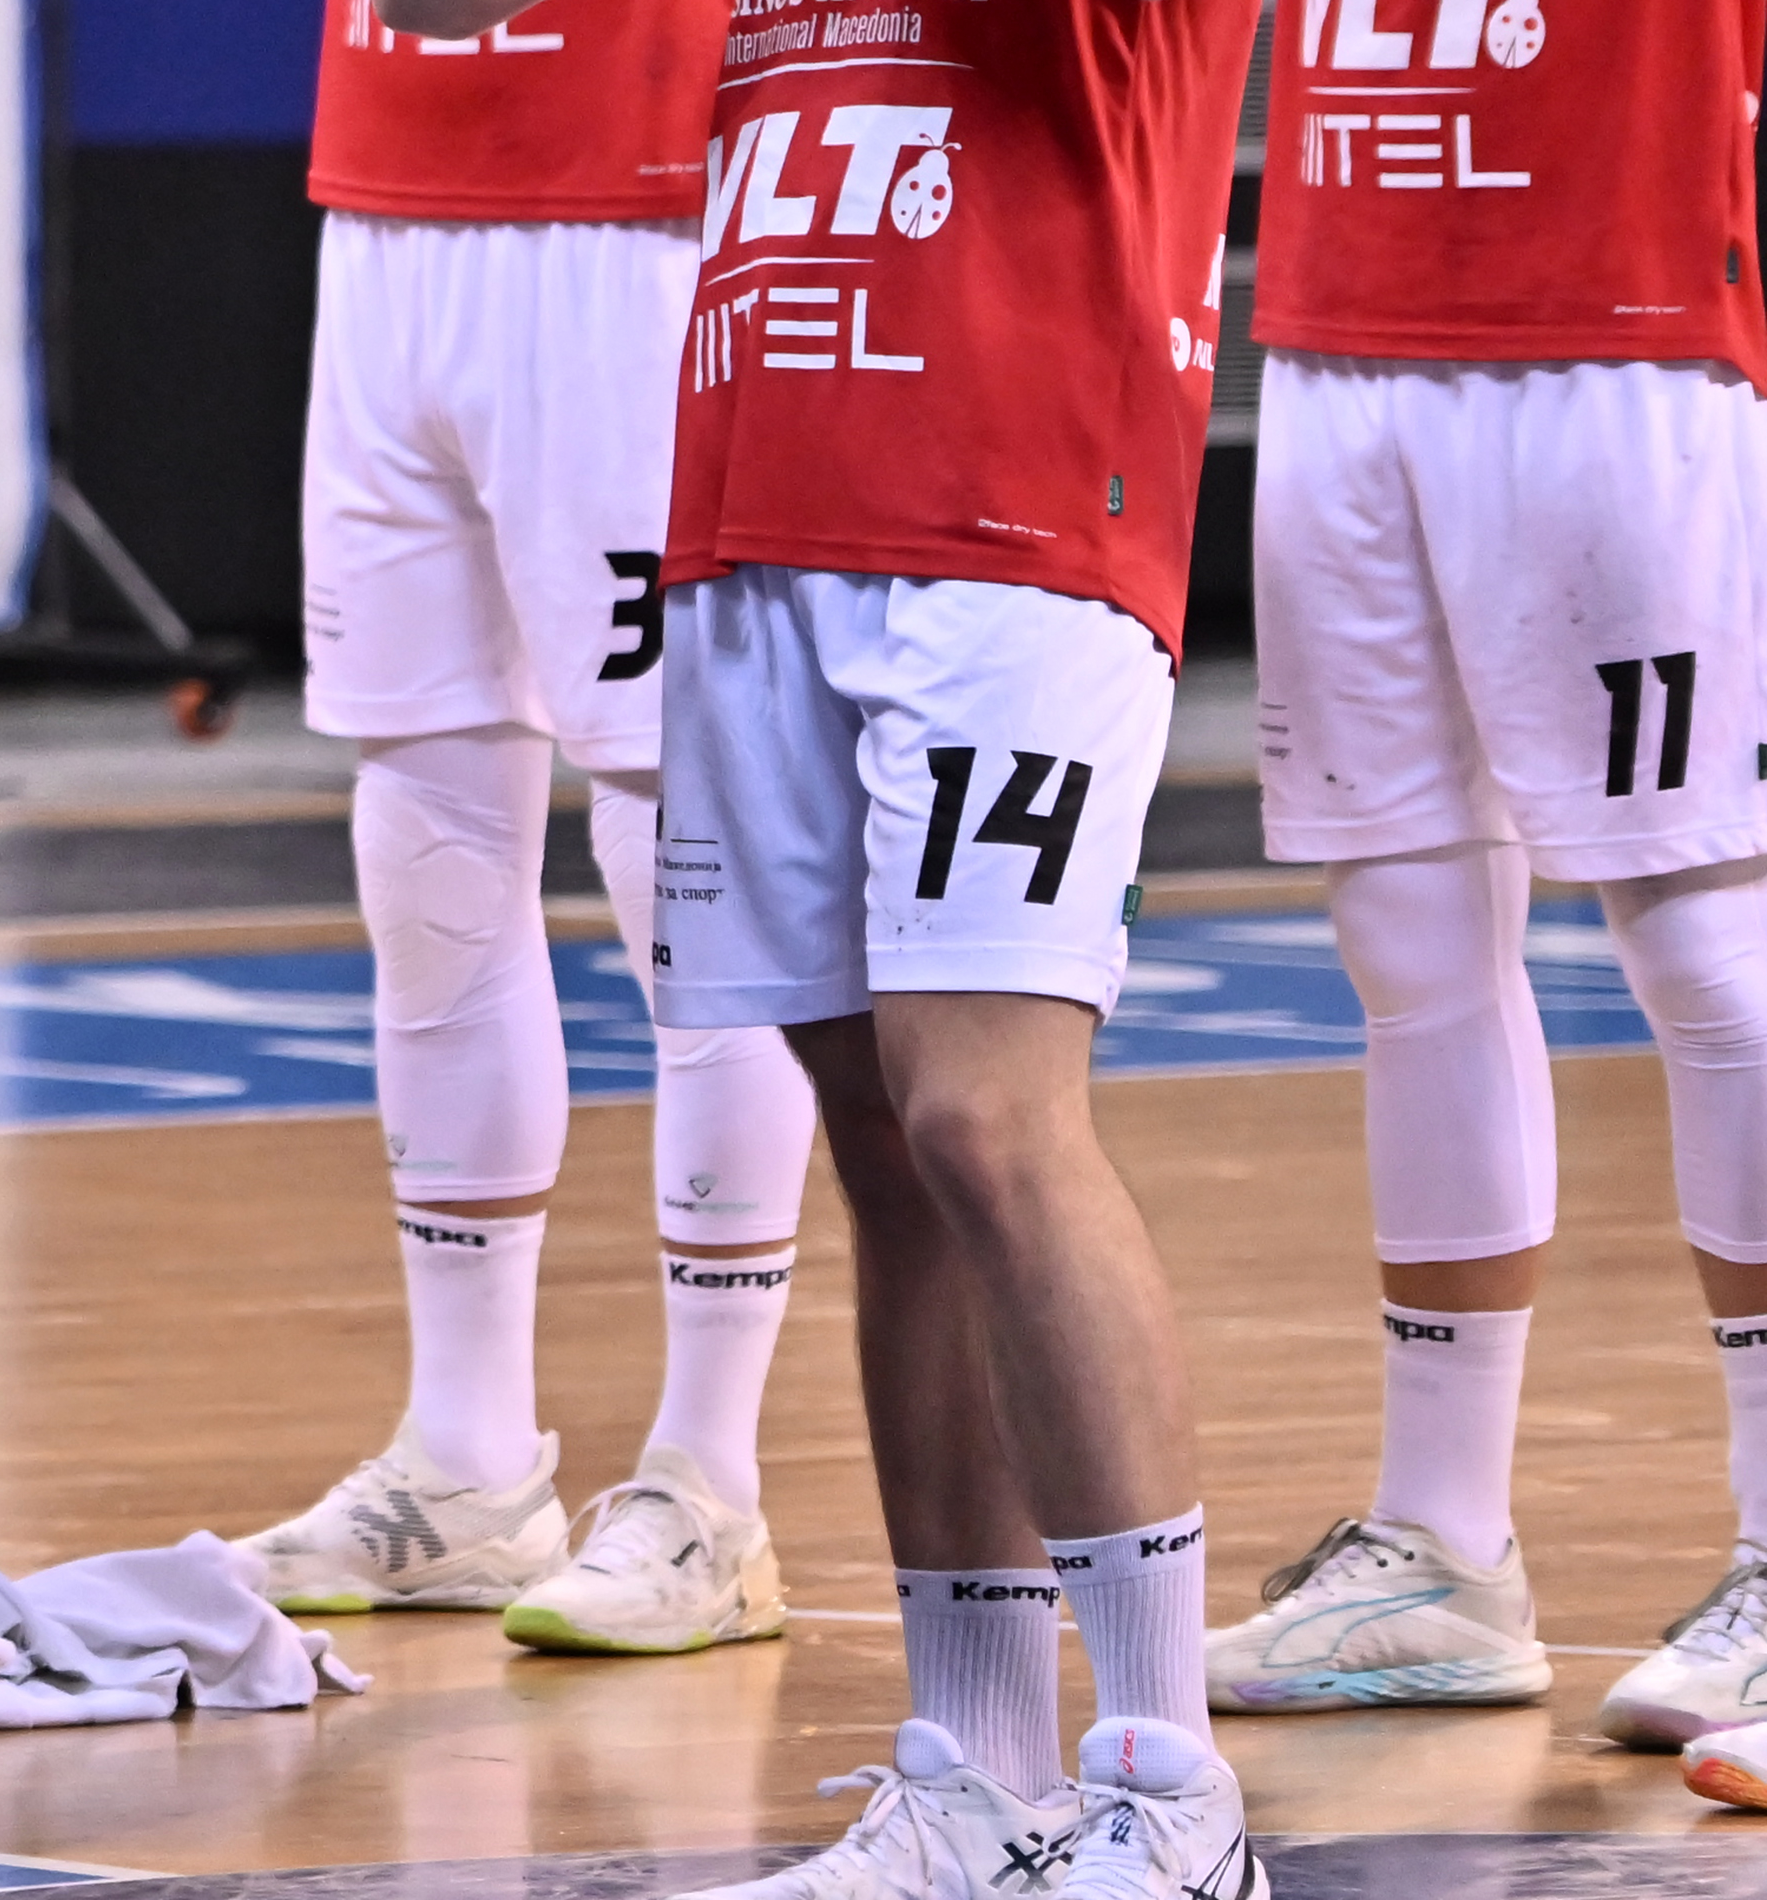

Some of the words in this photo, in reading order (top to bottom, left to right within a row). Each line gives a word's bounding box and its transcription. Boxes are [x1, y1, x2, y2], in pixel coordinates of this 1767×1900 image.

[822, 4, 922, 48] Macedonia
[1595, 651, 1697, 798] 11
[914, 746, 1094, 906] 14
[951, 1581, 1062, 1608] Kemp
